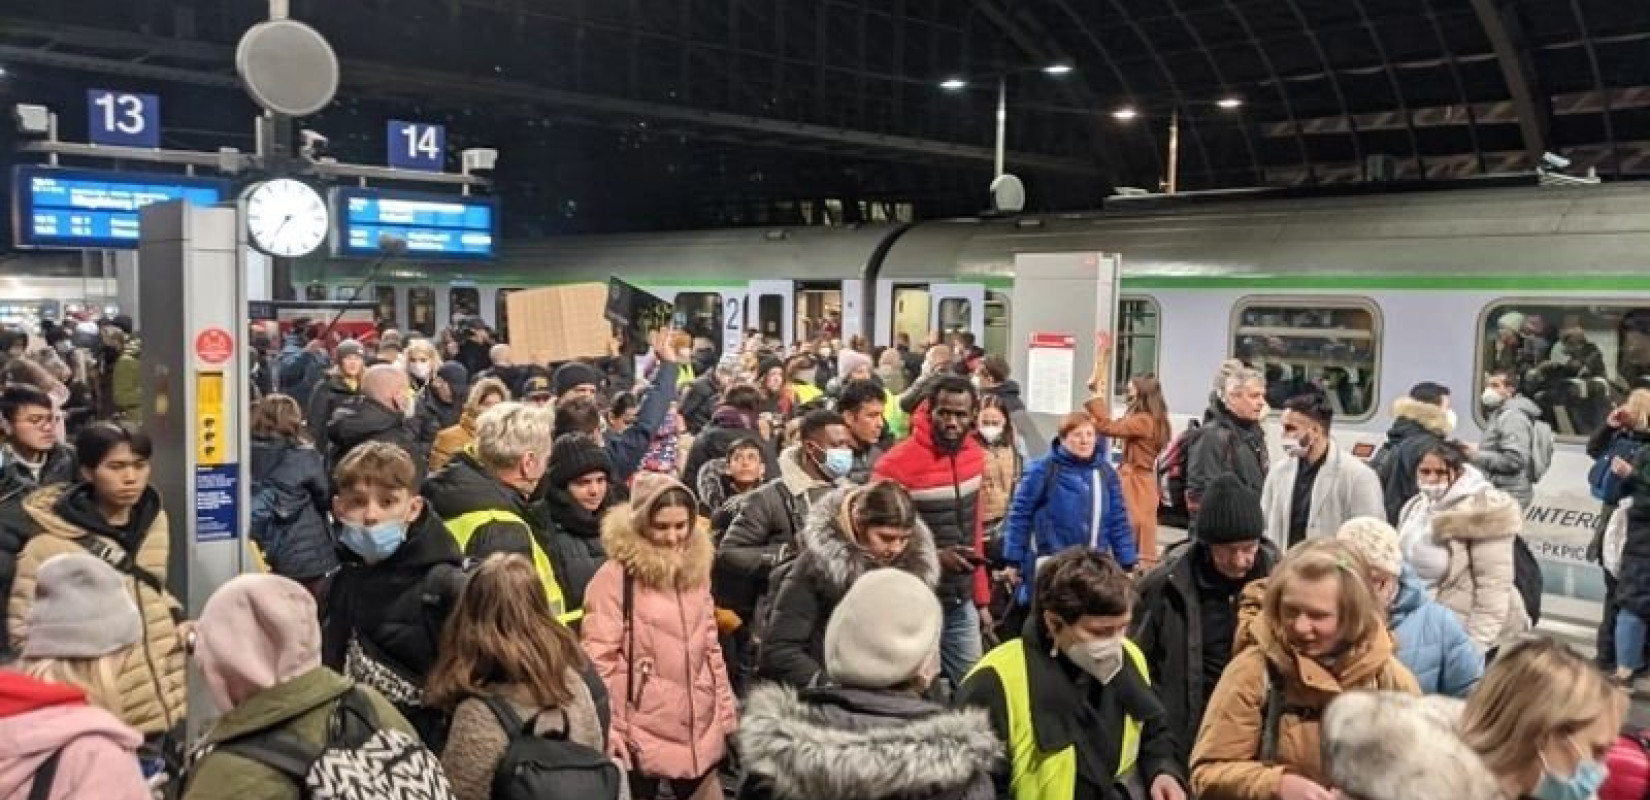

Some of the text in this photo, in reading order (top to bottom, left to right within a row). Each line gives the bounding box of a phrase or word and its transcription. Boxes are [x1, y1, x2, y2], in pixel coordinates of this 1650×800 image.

[95, 93, 145, 134] 13
[401, 124, 440, 160] 14
[726, 297, 739, 330] 2
